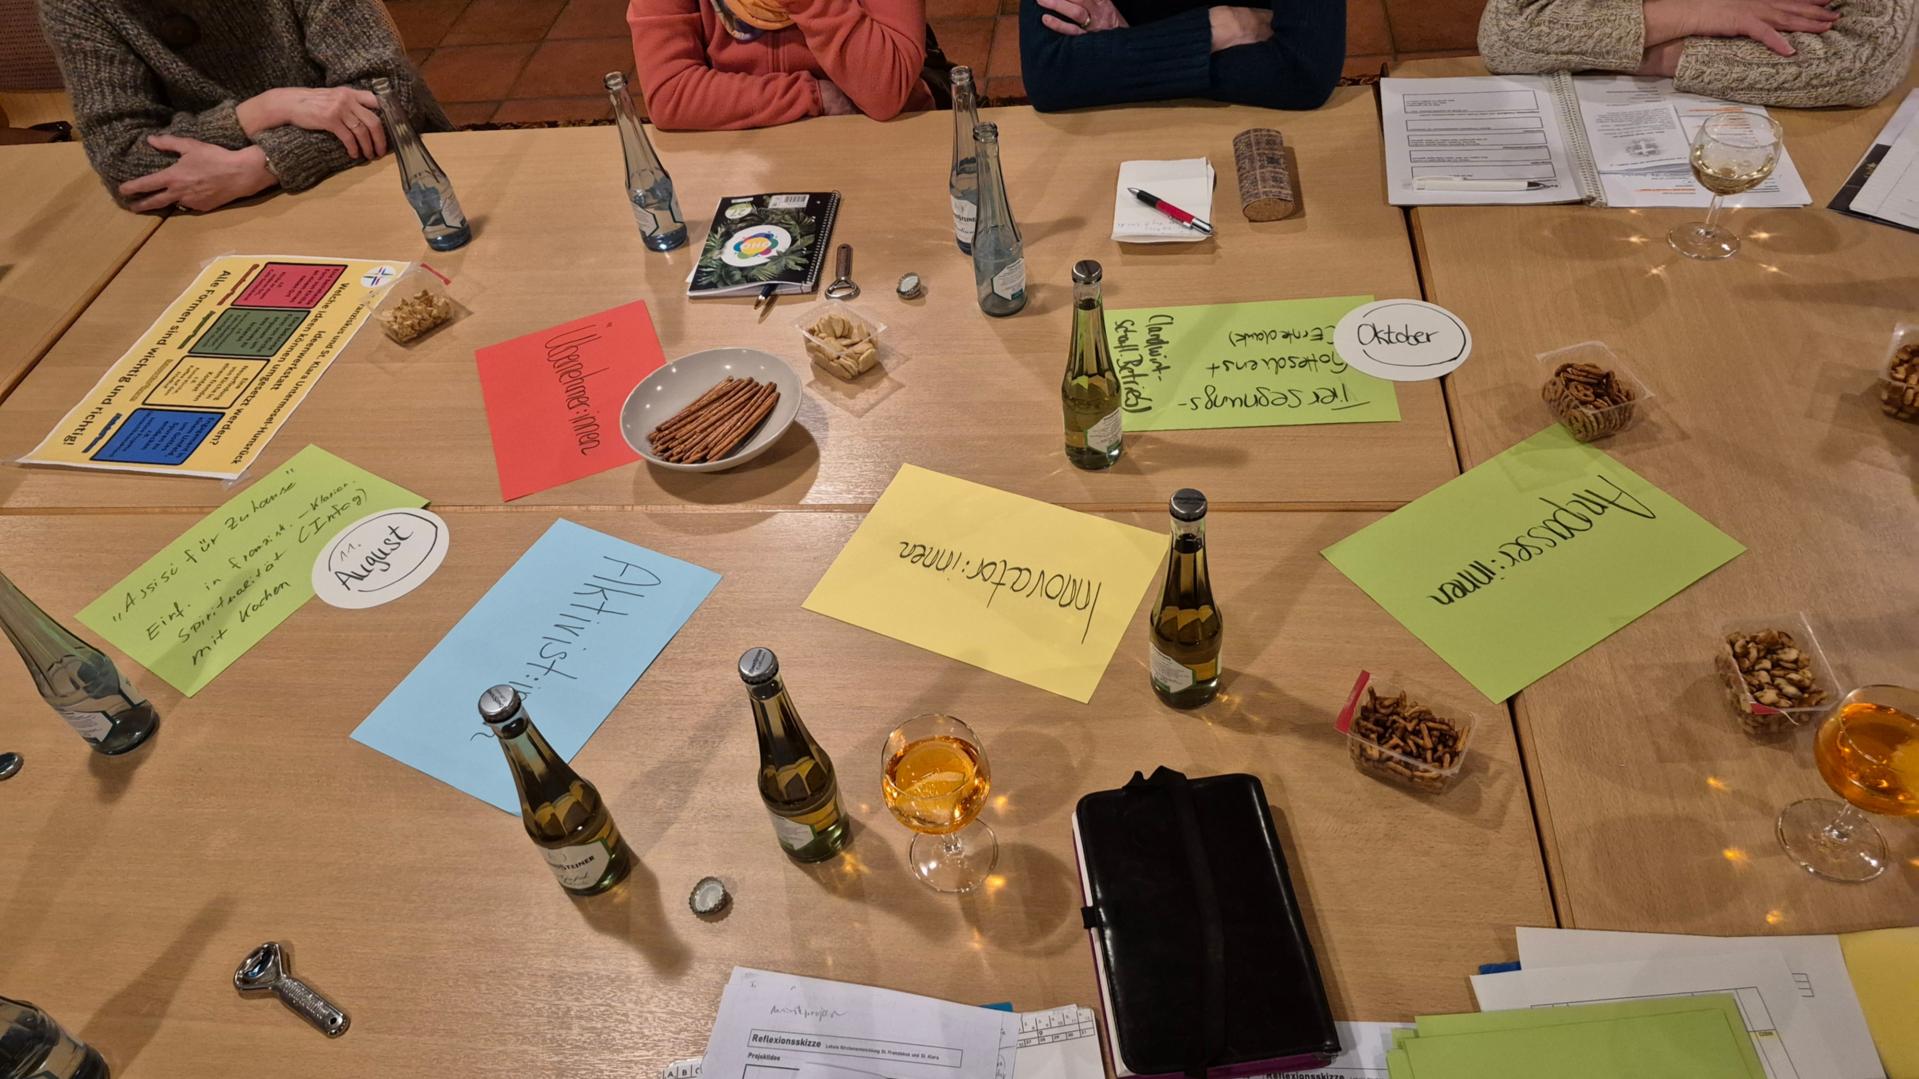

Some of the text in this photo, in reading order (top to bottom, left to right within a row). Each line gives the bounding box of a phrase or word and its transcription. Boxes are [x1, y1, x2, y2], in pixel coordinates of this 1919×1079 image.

[210, 270, 230, 287] Alle
[176, 289, 214, 322] Formen
[156, 325, 179, 345] sind
[325, 335, 339, 348] und
[1357, 322, 1441, 346] Oktober
[118, 347, 158, 382] wichtig
[209, 282, 349, 445] Welche Ideen können umgesetzt werden?
[270, 330, 325, 389] Ideenwerkstatt
[300, 361, 320, 379] Klara
[316, 350, 329, 359] St.
[1206, 351, 1348, 377] Gottesdienst
[101, 385, 124, 404] und
[63, 406, 102, 445] richtig!
[232, 380, 304, 463] Untermosel-Hunsrück
[184, 533, 221, 565] für
[334, 525, 415, 591] August
[177, 550, 288, 644] Spiritualität
[204, 577, 222, 592] in
[899, 541, 1102, 645] Innovator:innen
[191, 580, 292, 666] mit Kochen
[470, 555, 662, 742] Aktivist:i
[747, 1052, 781, 1062] Projektidee
[752, 1034, 822, 1049] Reflexionsskizze
